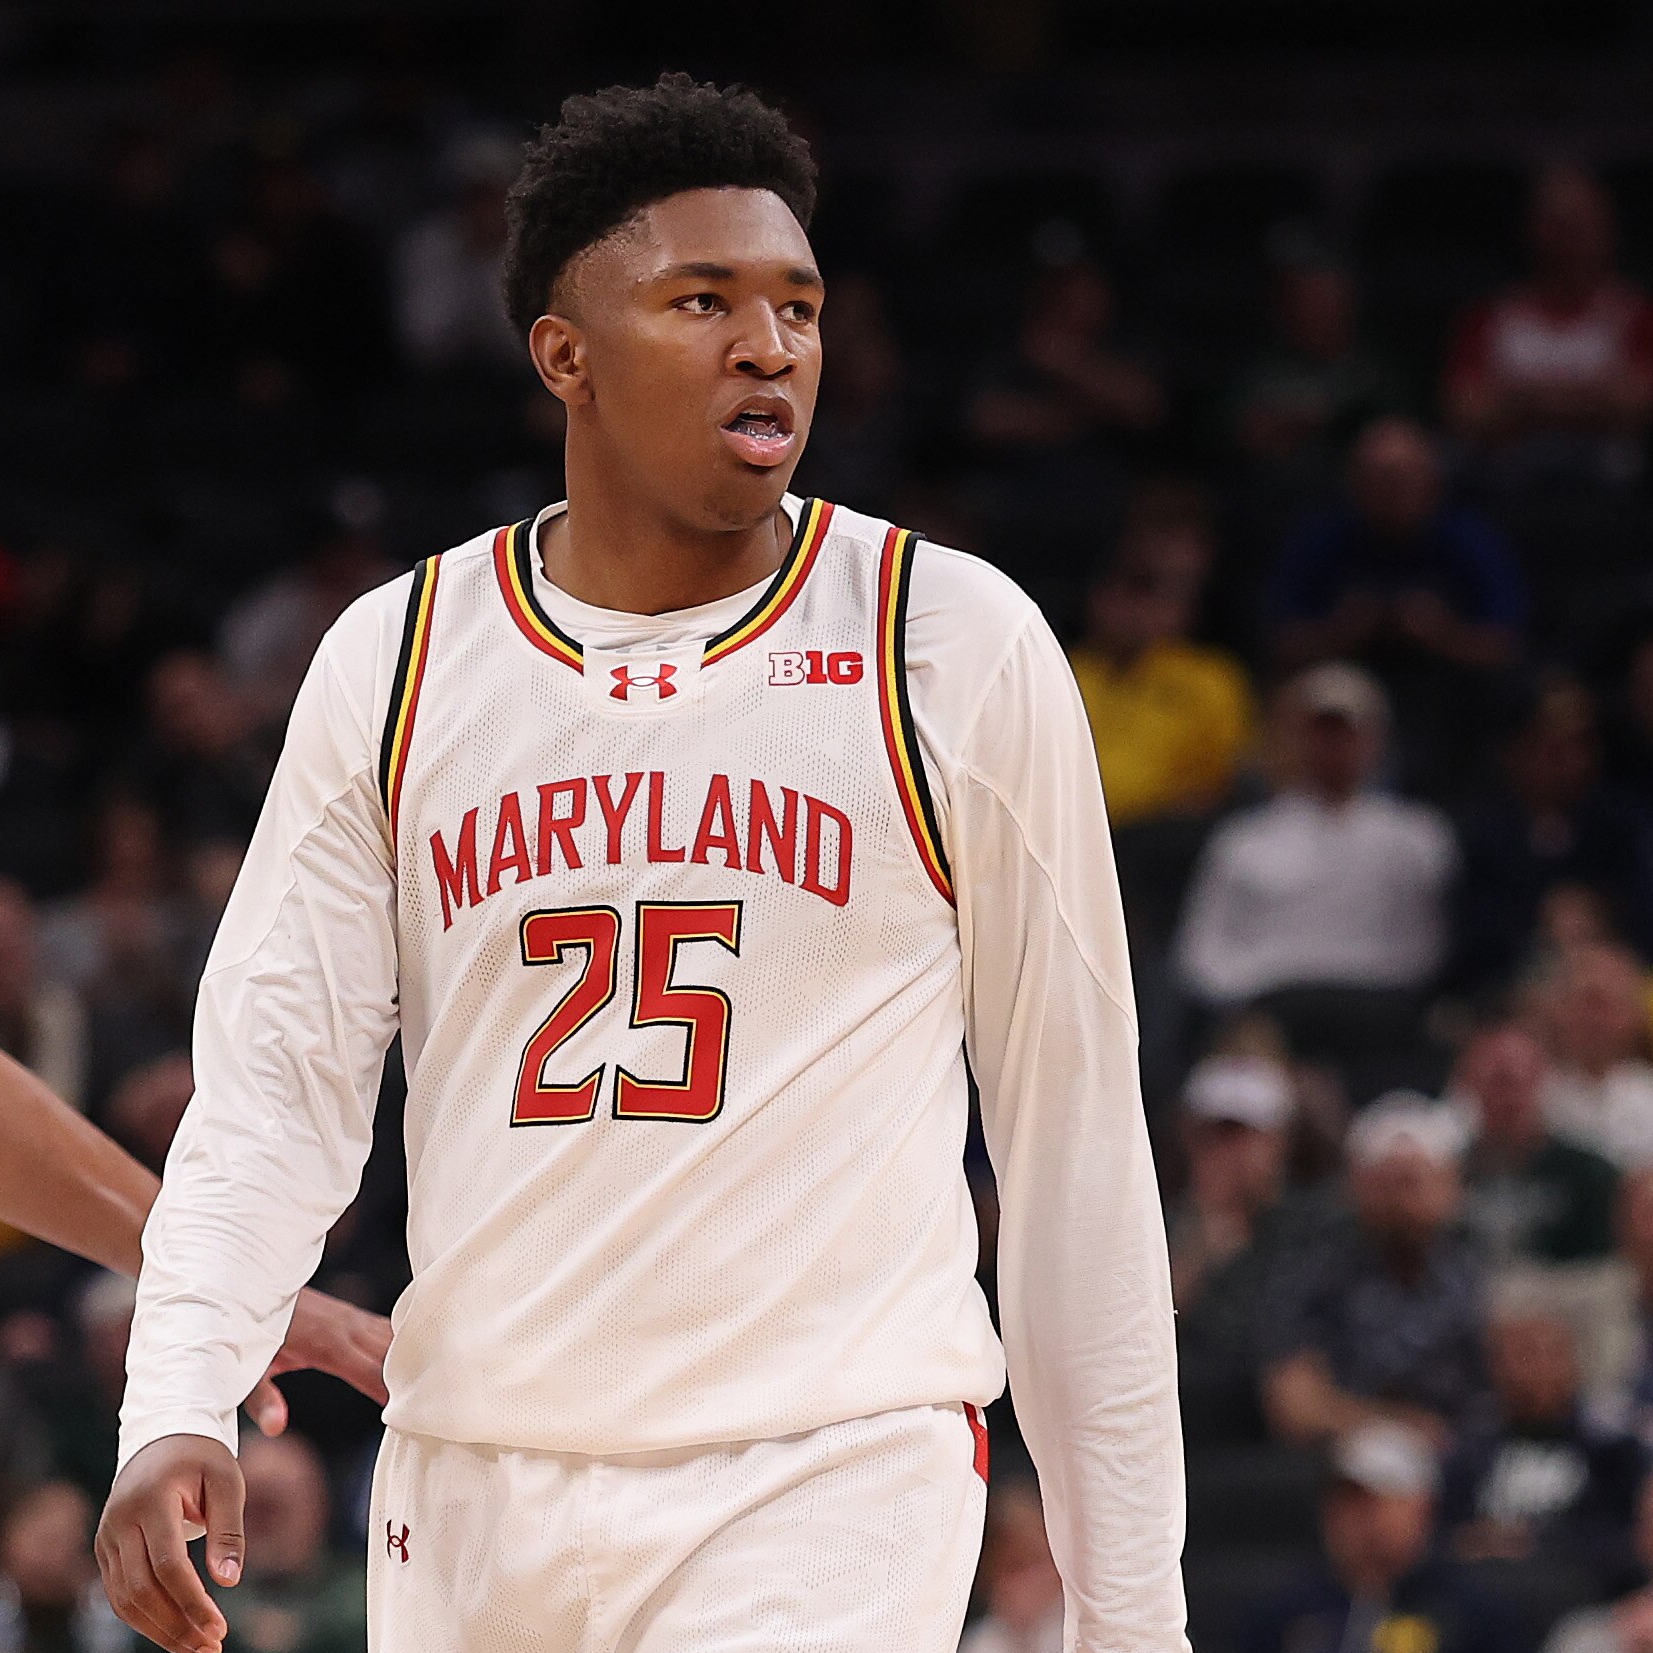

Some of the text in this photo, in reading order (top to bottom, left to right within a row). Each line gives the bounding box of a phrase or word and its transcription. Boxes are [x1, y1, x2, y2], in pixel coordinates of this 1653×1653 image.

[768, 651, 864, 686] B1G
[429, 771, 852, 932] MARYLAND
[510, 900, 743, 1127] 25
